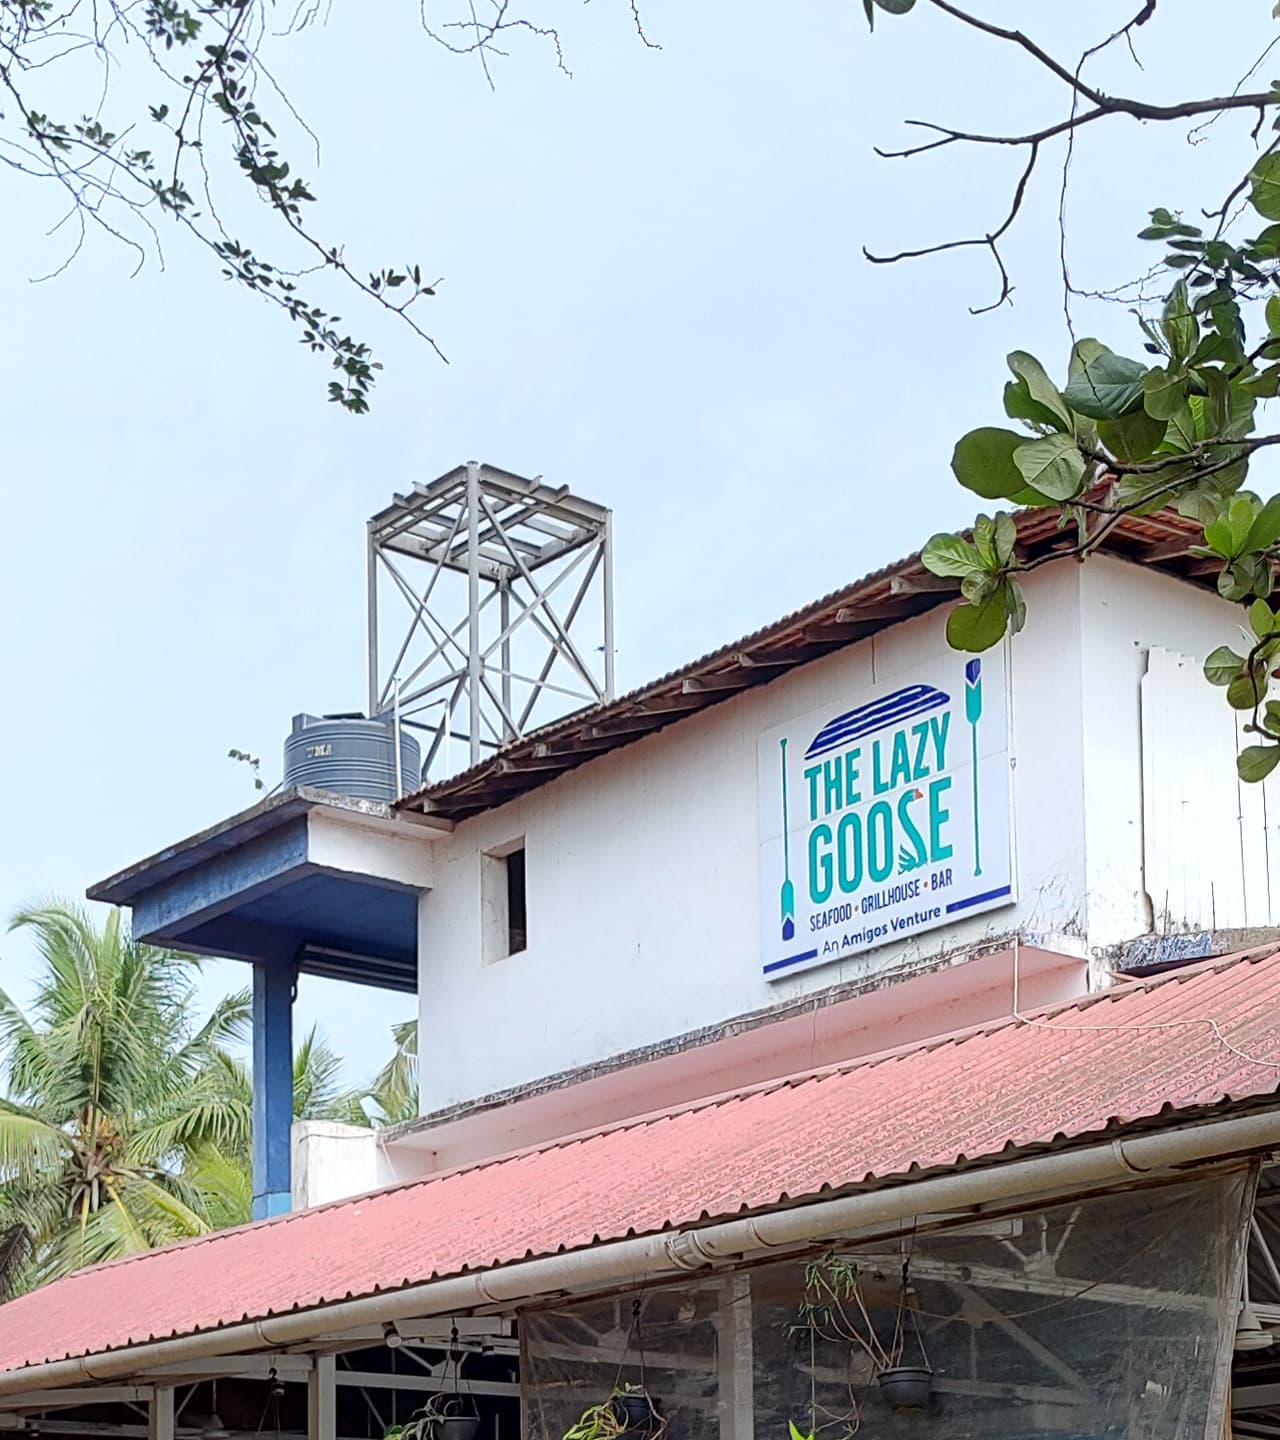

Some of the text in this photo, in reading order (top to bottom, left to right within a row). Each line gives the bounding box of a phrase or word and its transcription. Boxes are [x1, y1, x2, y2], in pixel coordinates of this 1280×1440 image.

[804, 711, 951, 821] THE LAZY
[808, 776, 953, 904] GOOSE
[810, 868, 953, 932] SEAFOOD GRILLHOUSE BAR
[822, 906, 941, 955] An Amigos Venture
